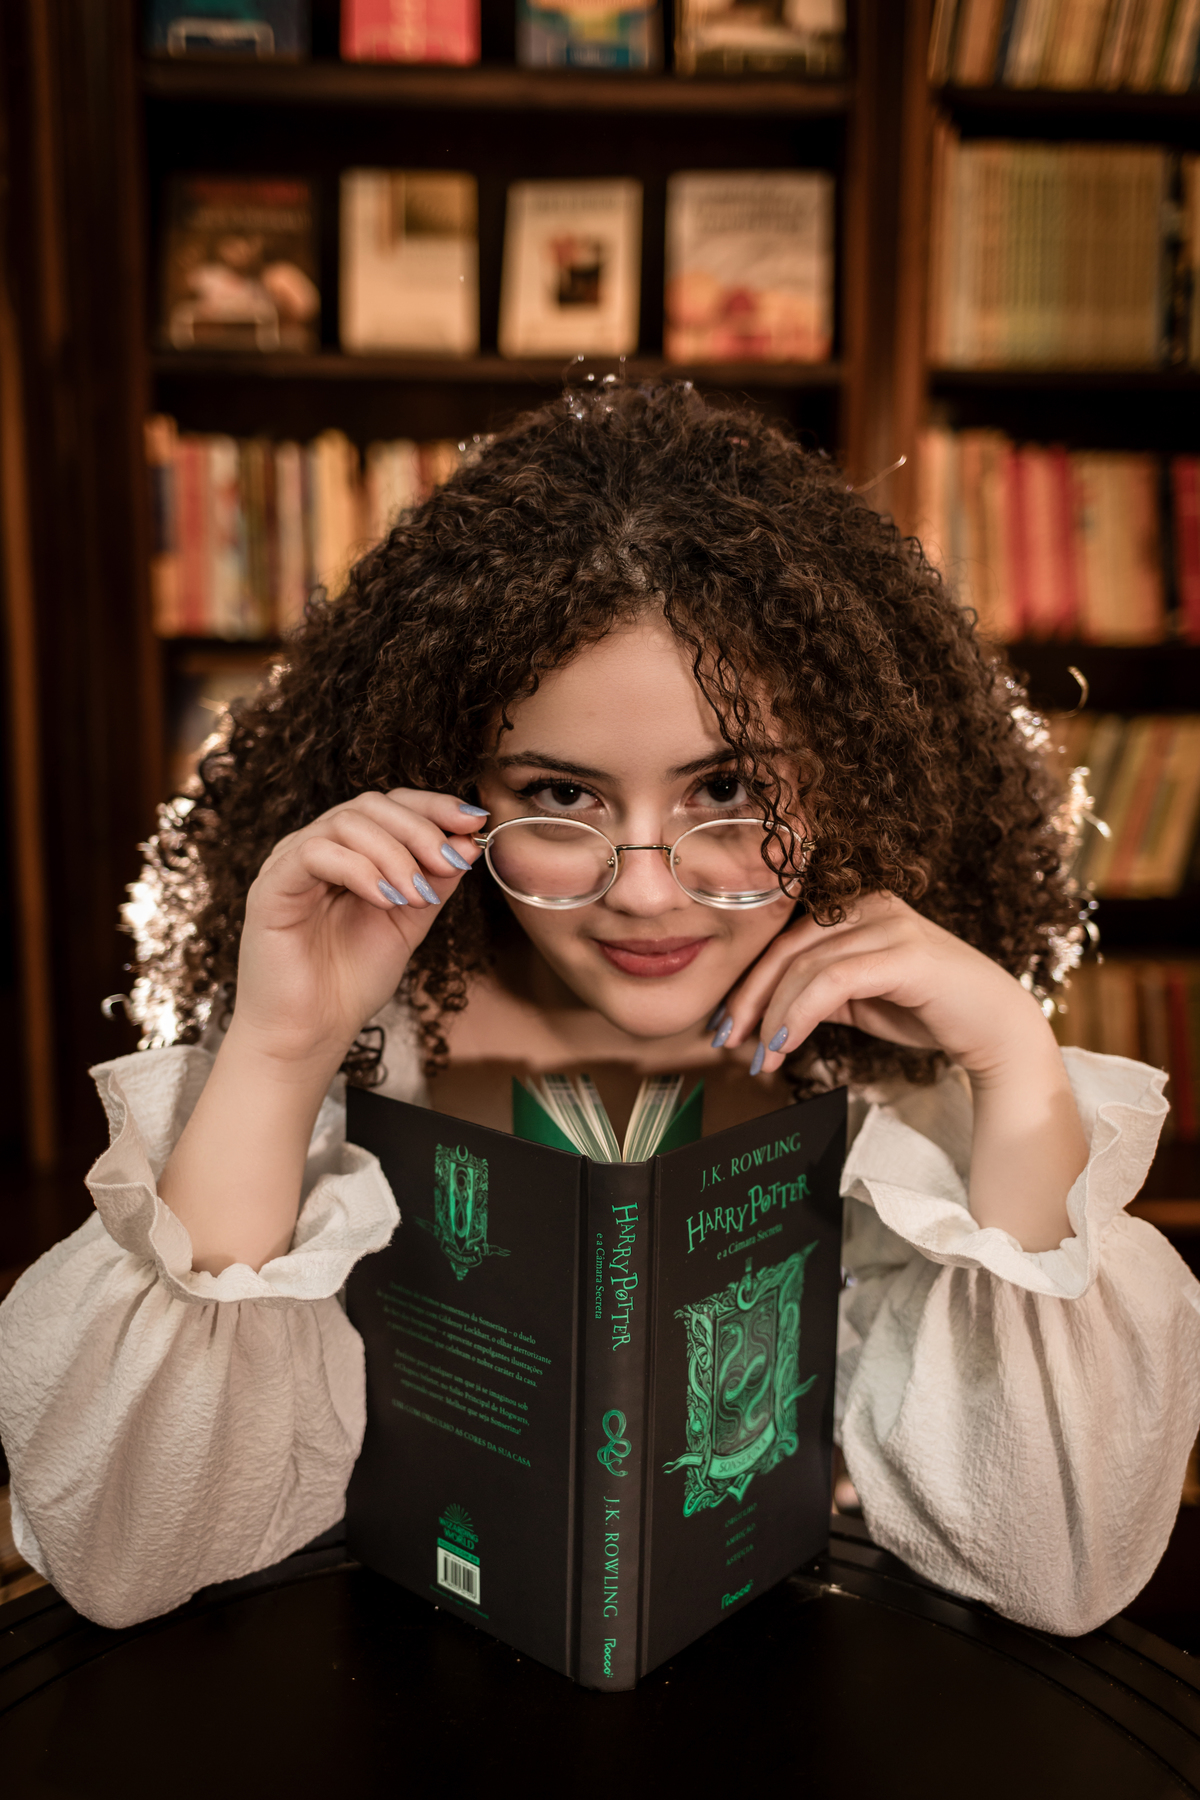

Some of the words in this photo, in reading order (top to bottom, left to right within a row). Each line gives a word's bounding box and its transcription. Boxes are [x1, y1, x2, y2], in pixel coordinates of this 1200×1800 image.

[700, 1163, 726, 1193] J.K.
[731, 1132, 801, 1177] ROWLING
[686, 1203, 749, 1254] HARRY
[747, 1173, 811, 1225] POTTER
[609, 1202, 639, 1275] HARRY
[595, 1248, 606, 1284] Câmara
[716, 1251, 723, 1260] e
[595, 1285, 605, 1319] Secreta
[610, 1272, 639, 1351] POTTER
[478, 1315, 507, 1333] Sonserina
[518, 1331, 536, 1345] duelo
[473, 1343, 510, 1362] empolgantes
[511, 1356, 542, 1375] ilustrações
[496, 1337, 512, 1349] olhar
[513, 1345, 551, 1365] aterrorizante
[476, 1357, 493, 1369] nobre
[494, 1365, 515, 1378] caráter
[515, 1371, 522, 1381] da
[523, 1377, 537, 1387] casa.
[488, 1389, 516, 1406] imaginou
[517, 1402, 528, 1411] sob
[499, 1405, 529, 1427] Hogwarts,
[490, 1415, 521, 1436] Sonserina!
[463, 1430, 486, 1447] CORES
[486, 1440, 497, 1452] DA
[497, 1445, 511, 1458] SUA
[512, 1452, 531, 1467] CASA
[603, 1496, 620, 1526] J.K.
[603, 1532, 620, 1617] ROWLING
